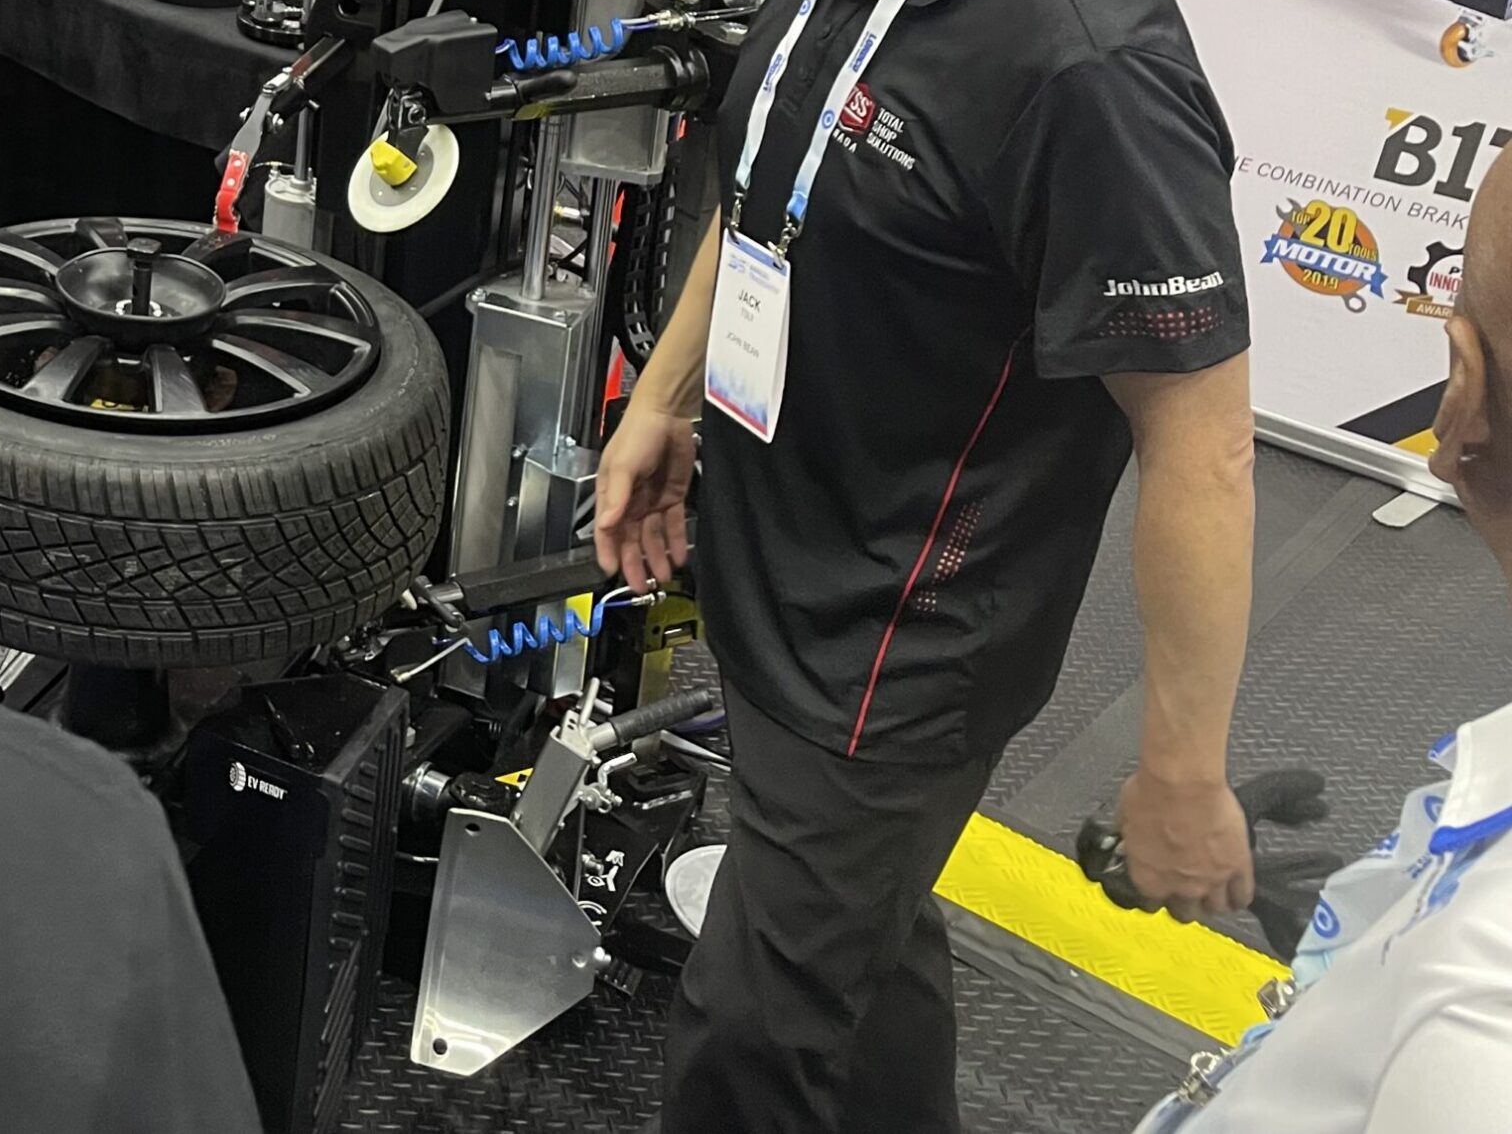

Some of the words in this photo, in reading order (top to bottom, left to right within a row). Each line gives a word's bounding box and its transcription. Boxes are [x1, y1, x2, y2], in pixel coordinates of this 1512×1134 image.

[871, 120, 898, 143] SHOP
[877, 107, 905, 133] TOTAL
[866, 132, 916, 171] SOLUTIONS
[1256, 162, 1402, 213] COMBINATION
[1290, 209, 1311, 226] TOP
[1299, 199, 1359, 253] 20
[1271, 238, 1378, 282] MOTOR
[1347, 242, 1378, 262] TOOLS
[1103, 271, 1224, 296] JohnBean
[1302, 269, 1340, 290] 2019
[737, 289, 762, 313] JACK
[248, 775, 258, 790] EV
[259, 780, 286, 801] READY
